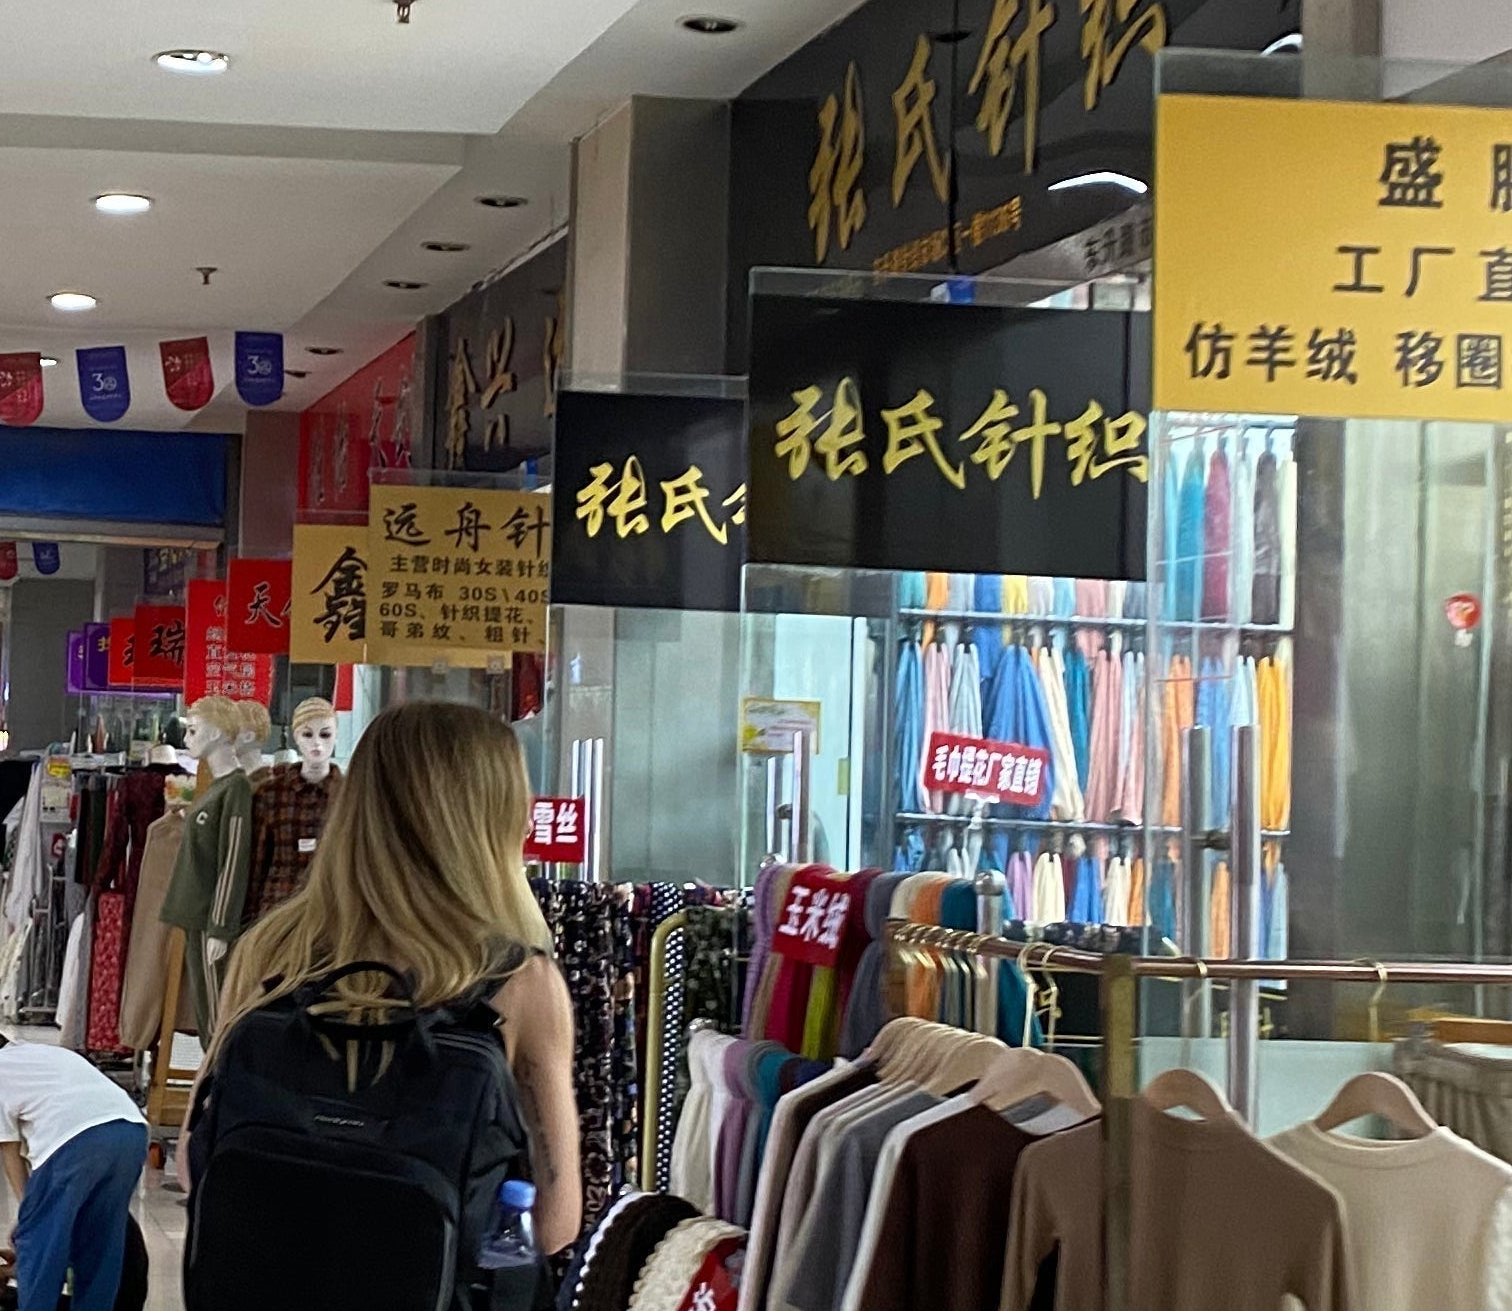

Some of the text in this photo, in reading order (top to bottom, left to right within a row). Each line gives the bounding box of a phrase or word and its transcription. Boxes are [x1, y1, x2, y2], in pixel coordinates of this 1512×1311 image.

[1184, 320, 1503, 390] 仿羊绒 移圈
[775, 376, 1150, 501] 张氏针织
[382, 582, 445, 600] 罗马布
[527, 801, 578, 845] 雪丝
